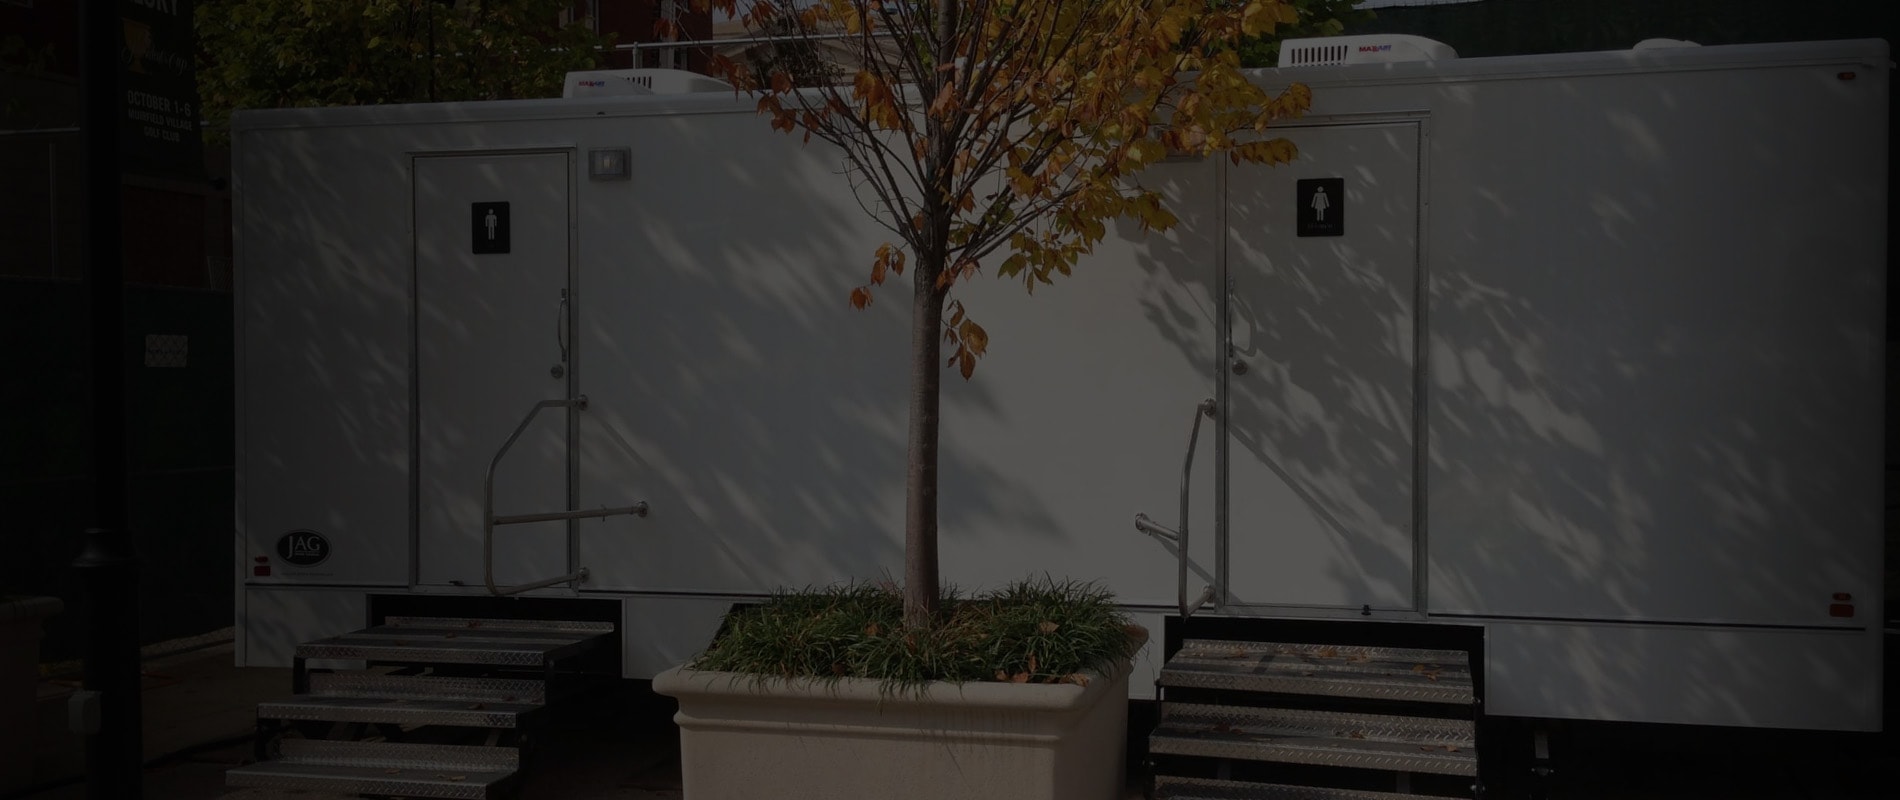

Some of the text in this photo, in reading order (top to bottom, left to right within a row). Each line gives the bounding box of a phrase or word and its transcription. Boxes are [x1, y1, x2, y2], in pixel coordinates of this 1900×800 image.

[128, 90, 191, 117] OCTOBER 1-6
[128, 108, 192, 131] MUIRFIELD VILLAGE
[144, 126, 180, 142] GOLF CLUB
[287, 536, 320, 559] JAG
